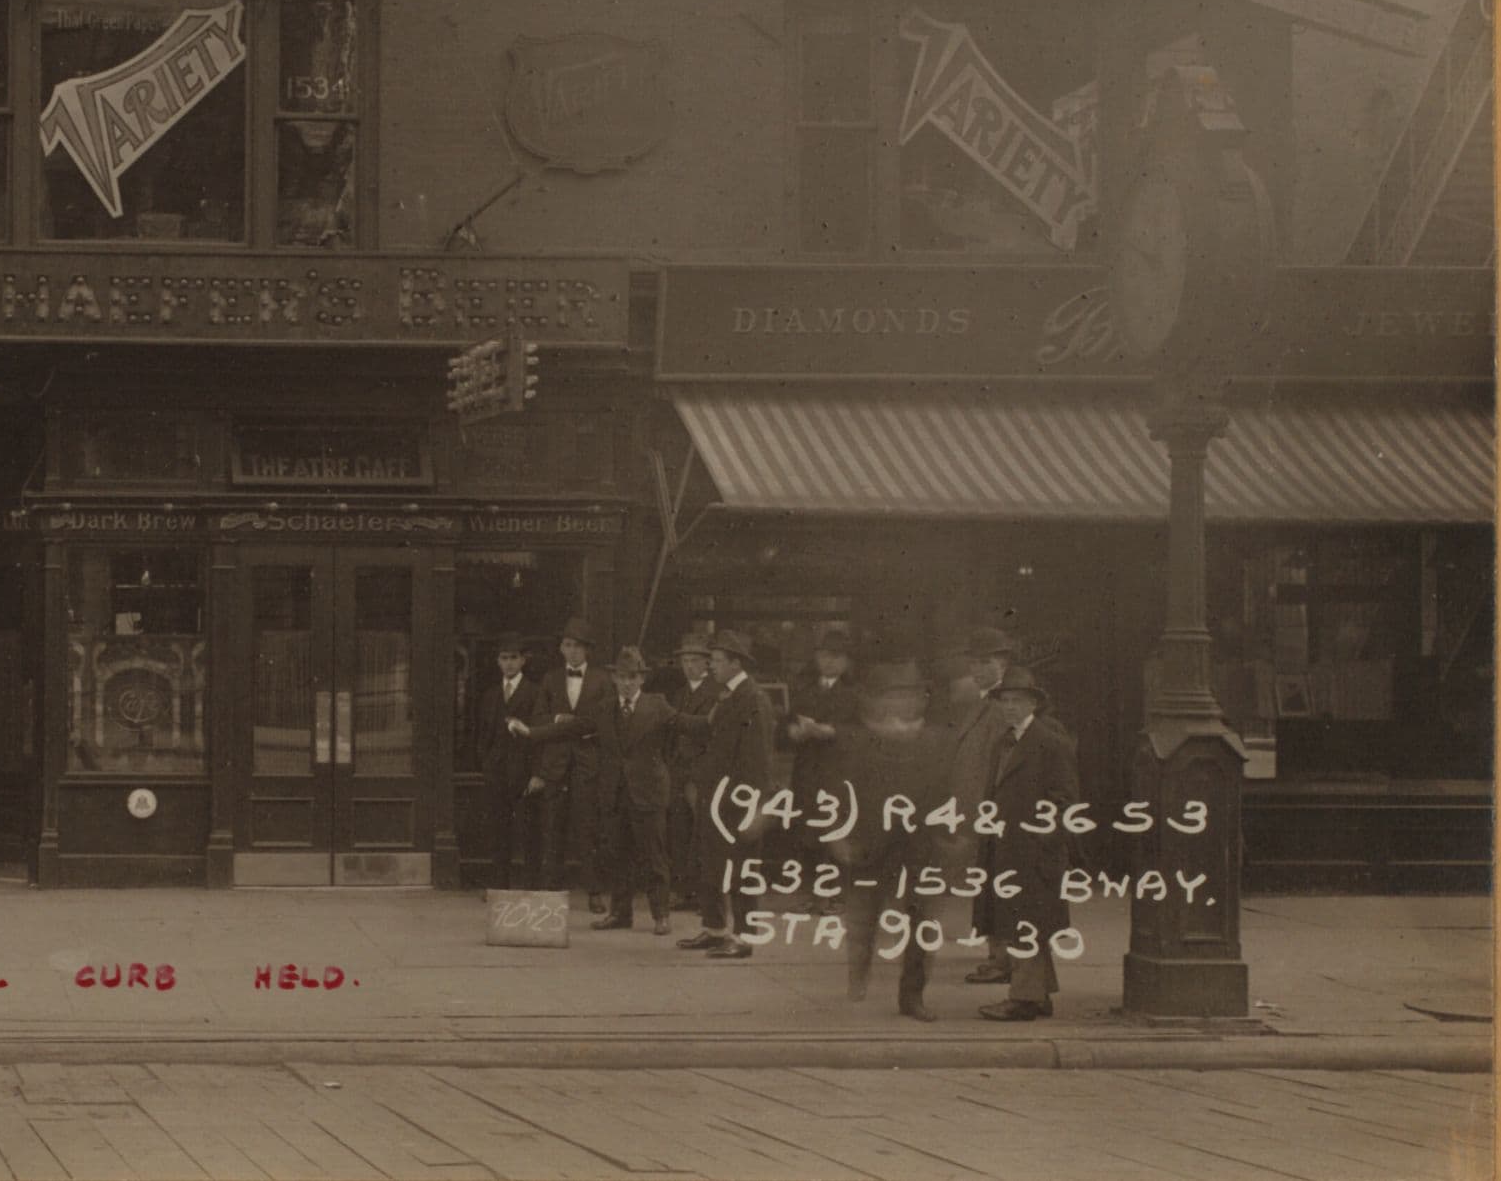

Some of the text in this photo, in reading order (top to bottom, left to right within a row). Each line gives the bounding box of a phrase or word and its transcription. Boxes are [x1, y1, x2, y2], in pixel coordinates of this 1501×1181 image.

[286, 76, 348, 100] 1534
[40, 0, 245, 216] VARIETY
[898, 11, 1098, 249] VARIETY
[397, 266, 601, 327] BEER
[732, 307, 972, 335] DIAMONDS
[250, 456, 350, 478] THEATRE
[136, 513, 198, 531] Brew
